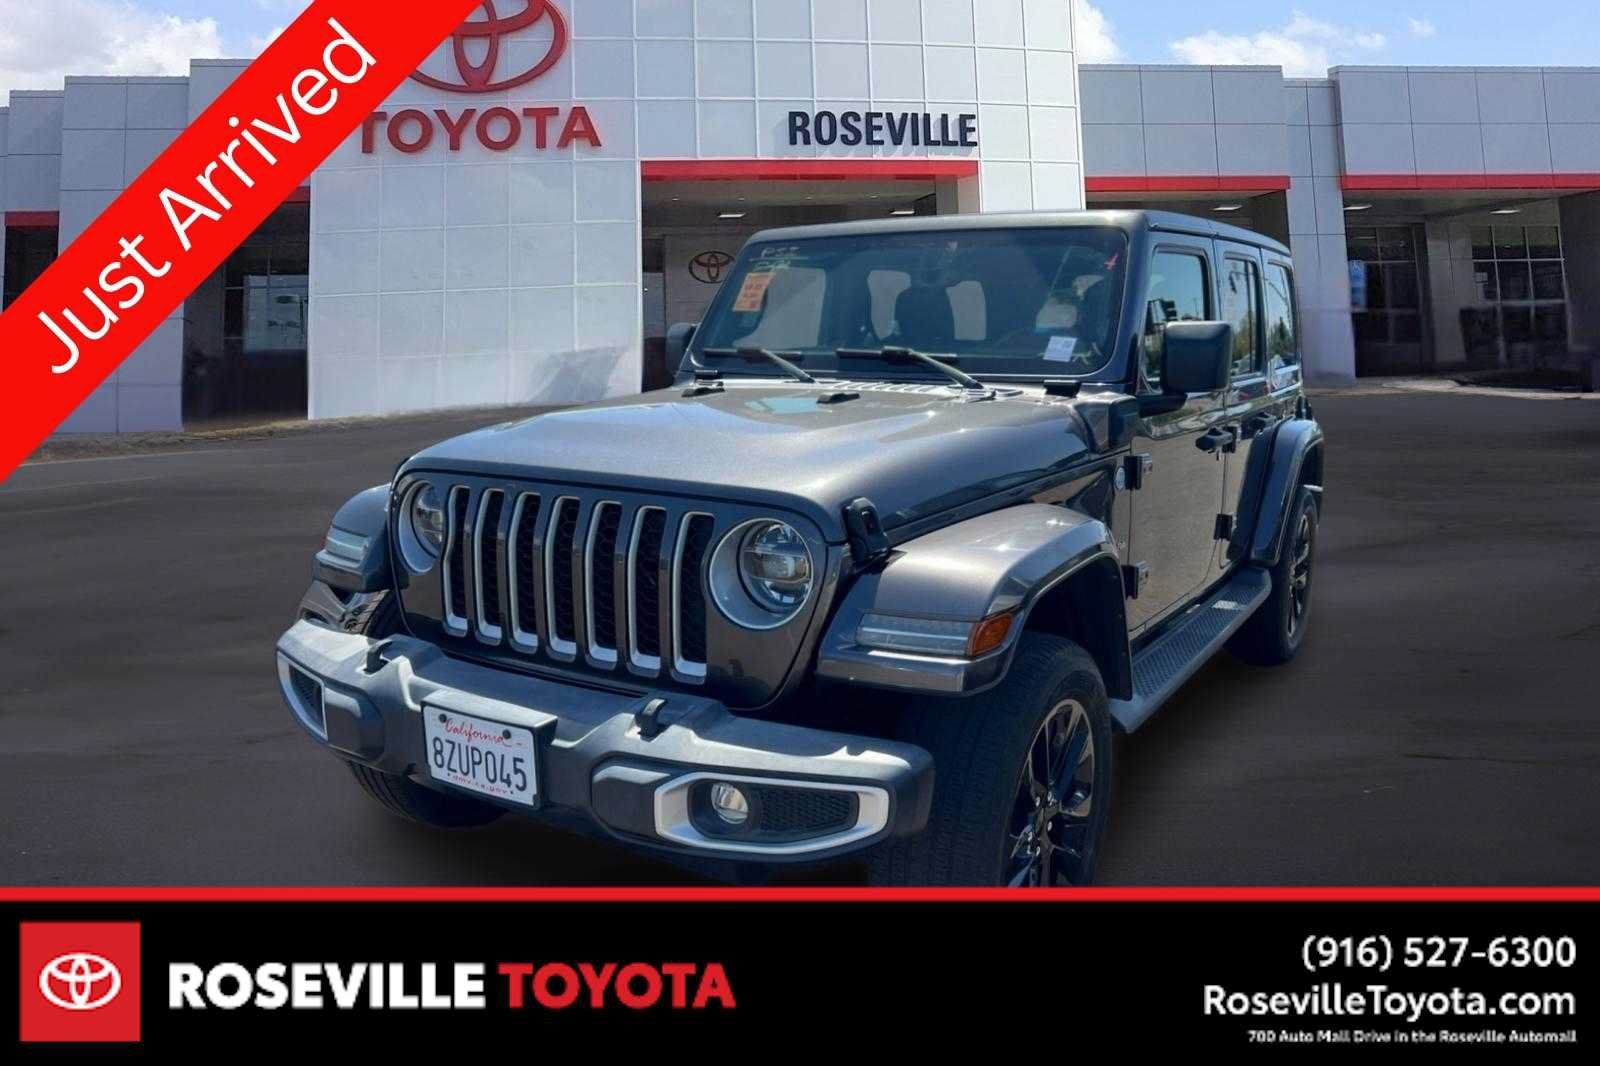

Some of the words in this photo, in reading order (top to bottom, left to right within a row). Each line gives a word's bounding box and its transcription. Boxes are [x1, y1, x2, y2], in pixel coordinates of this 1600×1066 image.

[361, 106, 602, 154] TOYOTA
[788, 110, 978, 147] ROSEVILLE
[432, 736, 528, 792] 8ZUP045
